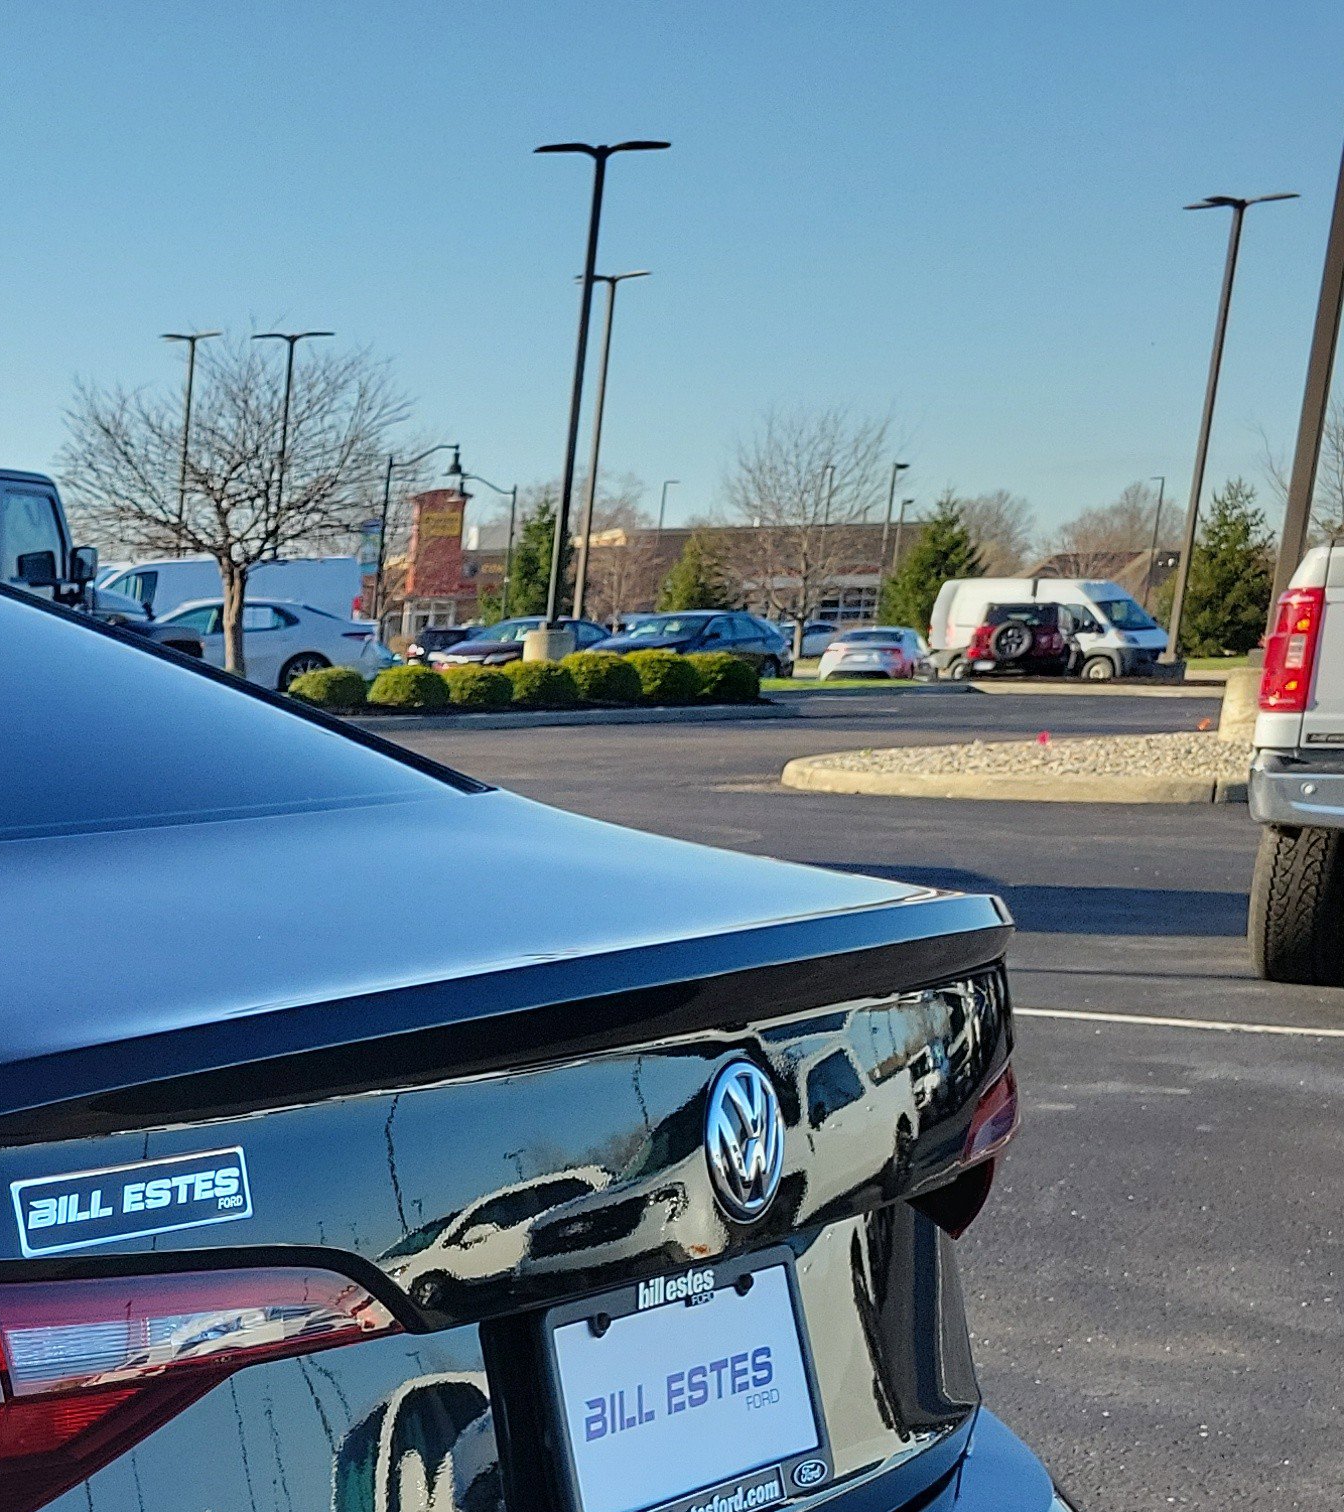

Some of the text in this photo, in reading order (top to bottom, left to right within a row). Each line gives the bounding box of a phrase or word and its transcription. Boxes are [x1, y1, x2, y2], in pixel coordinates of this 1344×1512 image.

[28, 1167, 241, 1229] BILL ESTES
[217, 1194, 244, 1210] FORD
[584, 1346, 774, 1442] BILL ESTES
[745, 1387, 780, 1411] FORD
